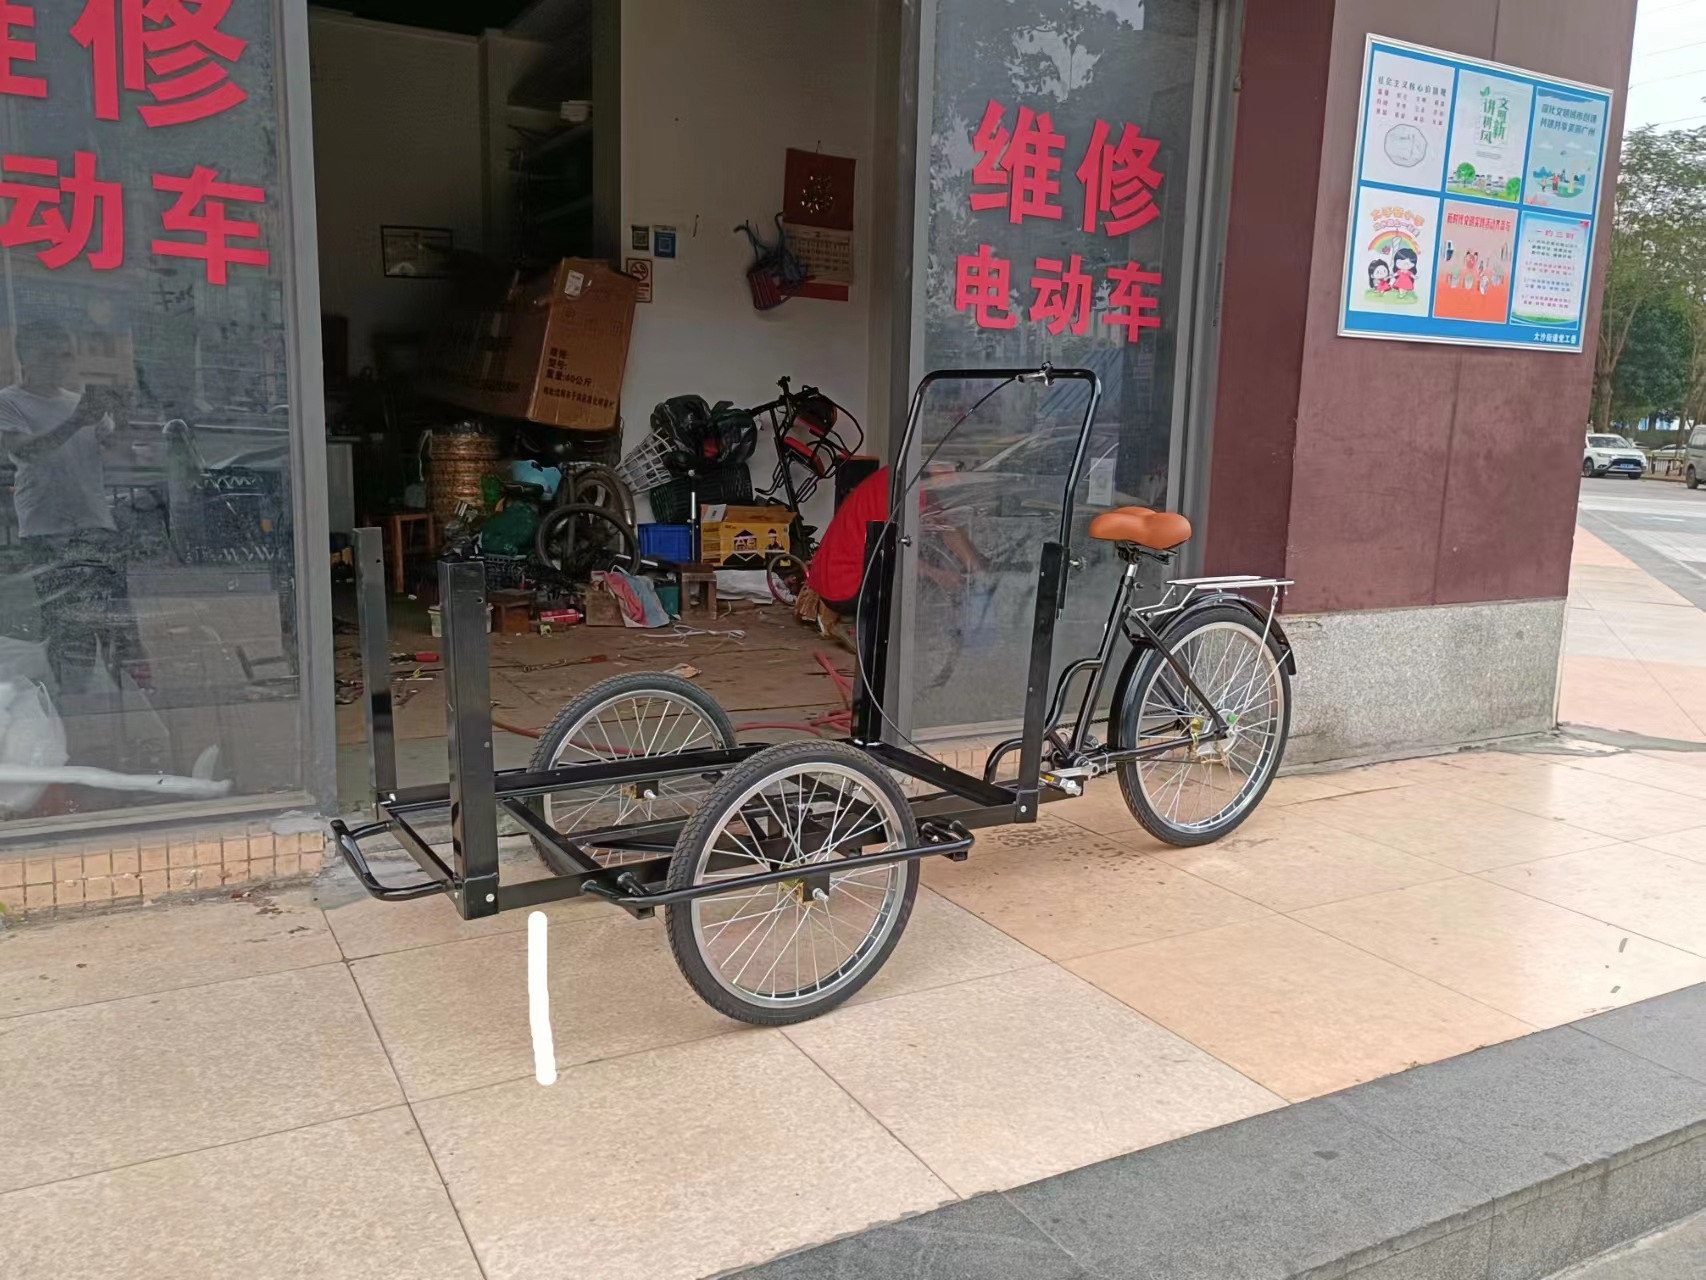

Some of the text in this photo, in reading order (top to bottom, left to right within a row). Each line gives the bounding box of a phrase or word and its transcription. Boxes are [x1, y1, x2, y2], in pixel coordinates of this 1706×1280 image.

[969, 99, 1164, 237] 维修
[954, 243, 1163, 343] 电动车
